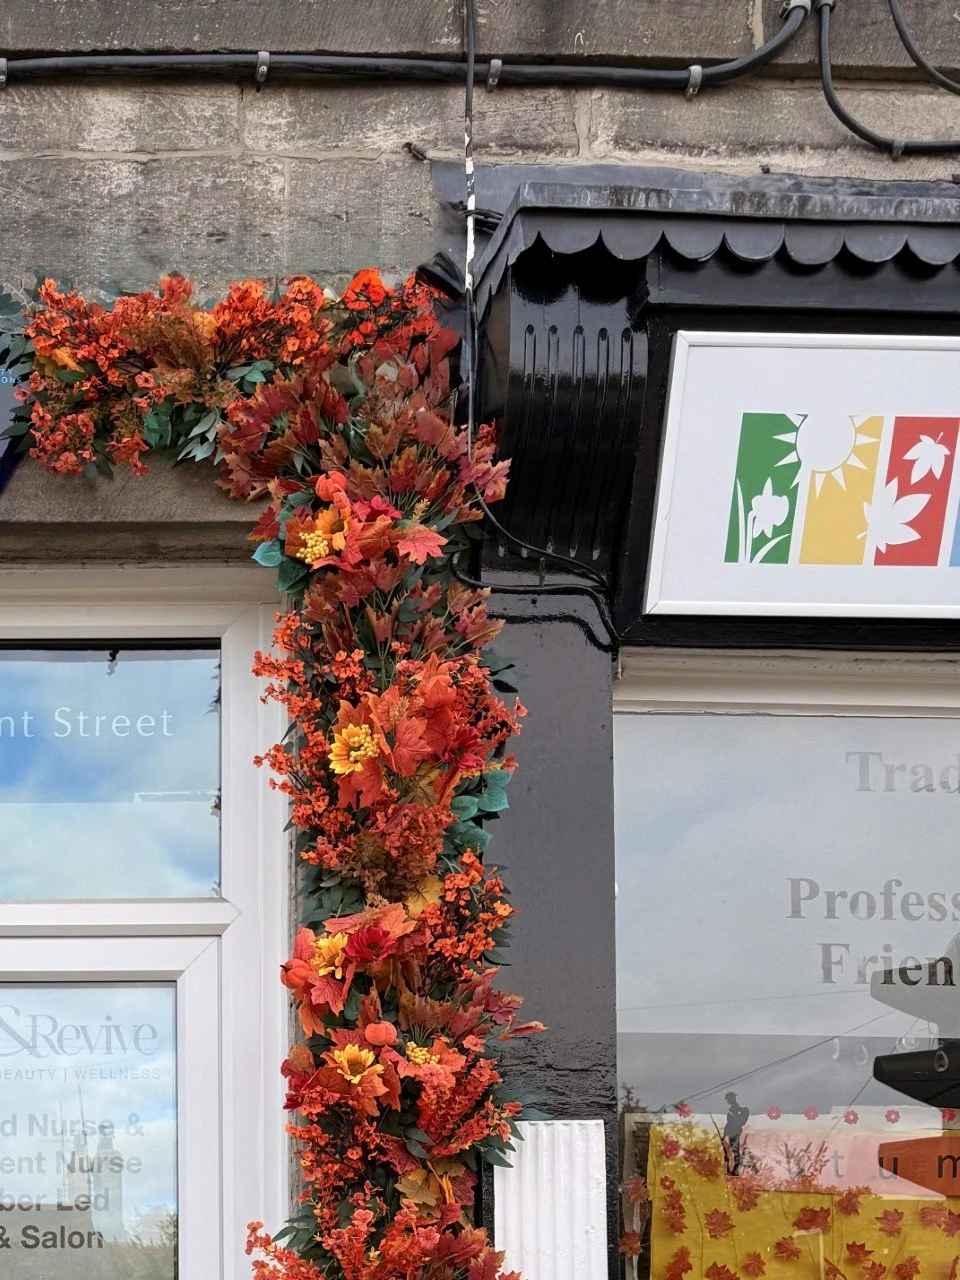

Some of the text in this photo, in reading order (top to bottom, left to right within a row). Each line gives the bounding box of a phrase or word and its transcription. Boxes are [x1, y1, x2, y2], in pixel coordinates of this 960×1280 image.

[53, 706, 175, 738] Street
[844, 750, 960, 794] Trad
[816, 943, 957, 987] Frien
[75, 1068, 161, 1080] WELLNESS
[28, 1113, 116, 1137] Nurse
[125, 1112, 145, 1137] &
[55, 1151, 143, 1175] Nurse
[56, 1187, 110, 1212] Led
[21, 1225, 103, 1249] Salon
